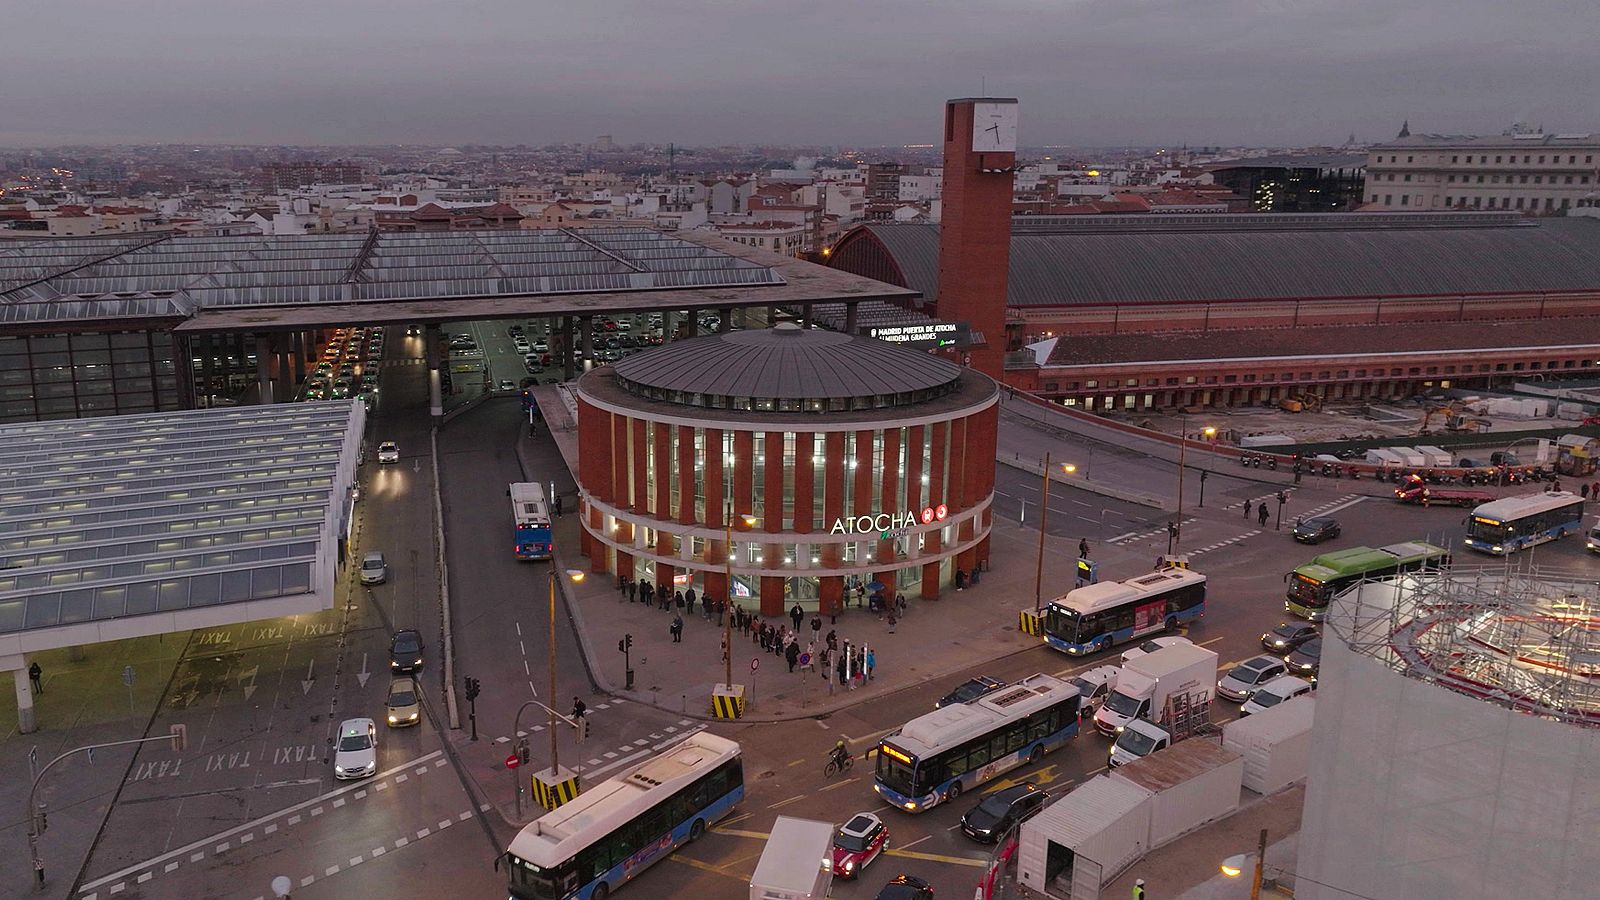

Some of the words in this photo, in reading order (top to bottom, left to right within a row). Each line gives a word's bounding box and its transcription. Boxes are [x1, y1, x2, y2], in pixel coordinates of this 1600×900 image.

[903, 326, 924, 334] PUERTA
[934, 324, 956, 332] ATOCHA
[911, 333, 936, 341] GRANDES
[830, 510, 917, 536] ATOCHA
[252, 627, 284, 641] TAXI
[304, 623, 335, 636] TAXI
[200, 631, 232, 645] TAXI
[205, 751, 250, 772] TAXI
[273, 744, 317, 765] TAXI
[135, 758, 182, 781] TAXI
